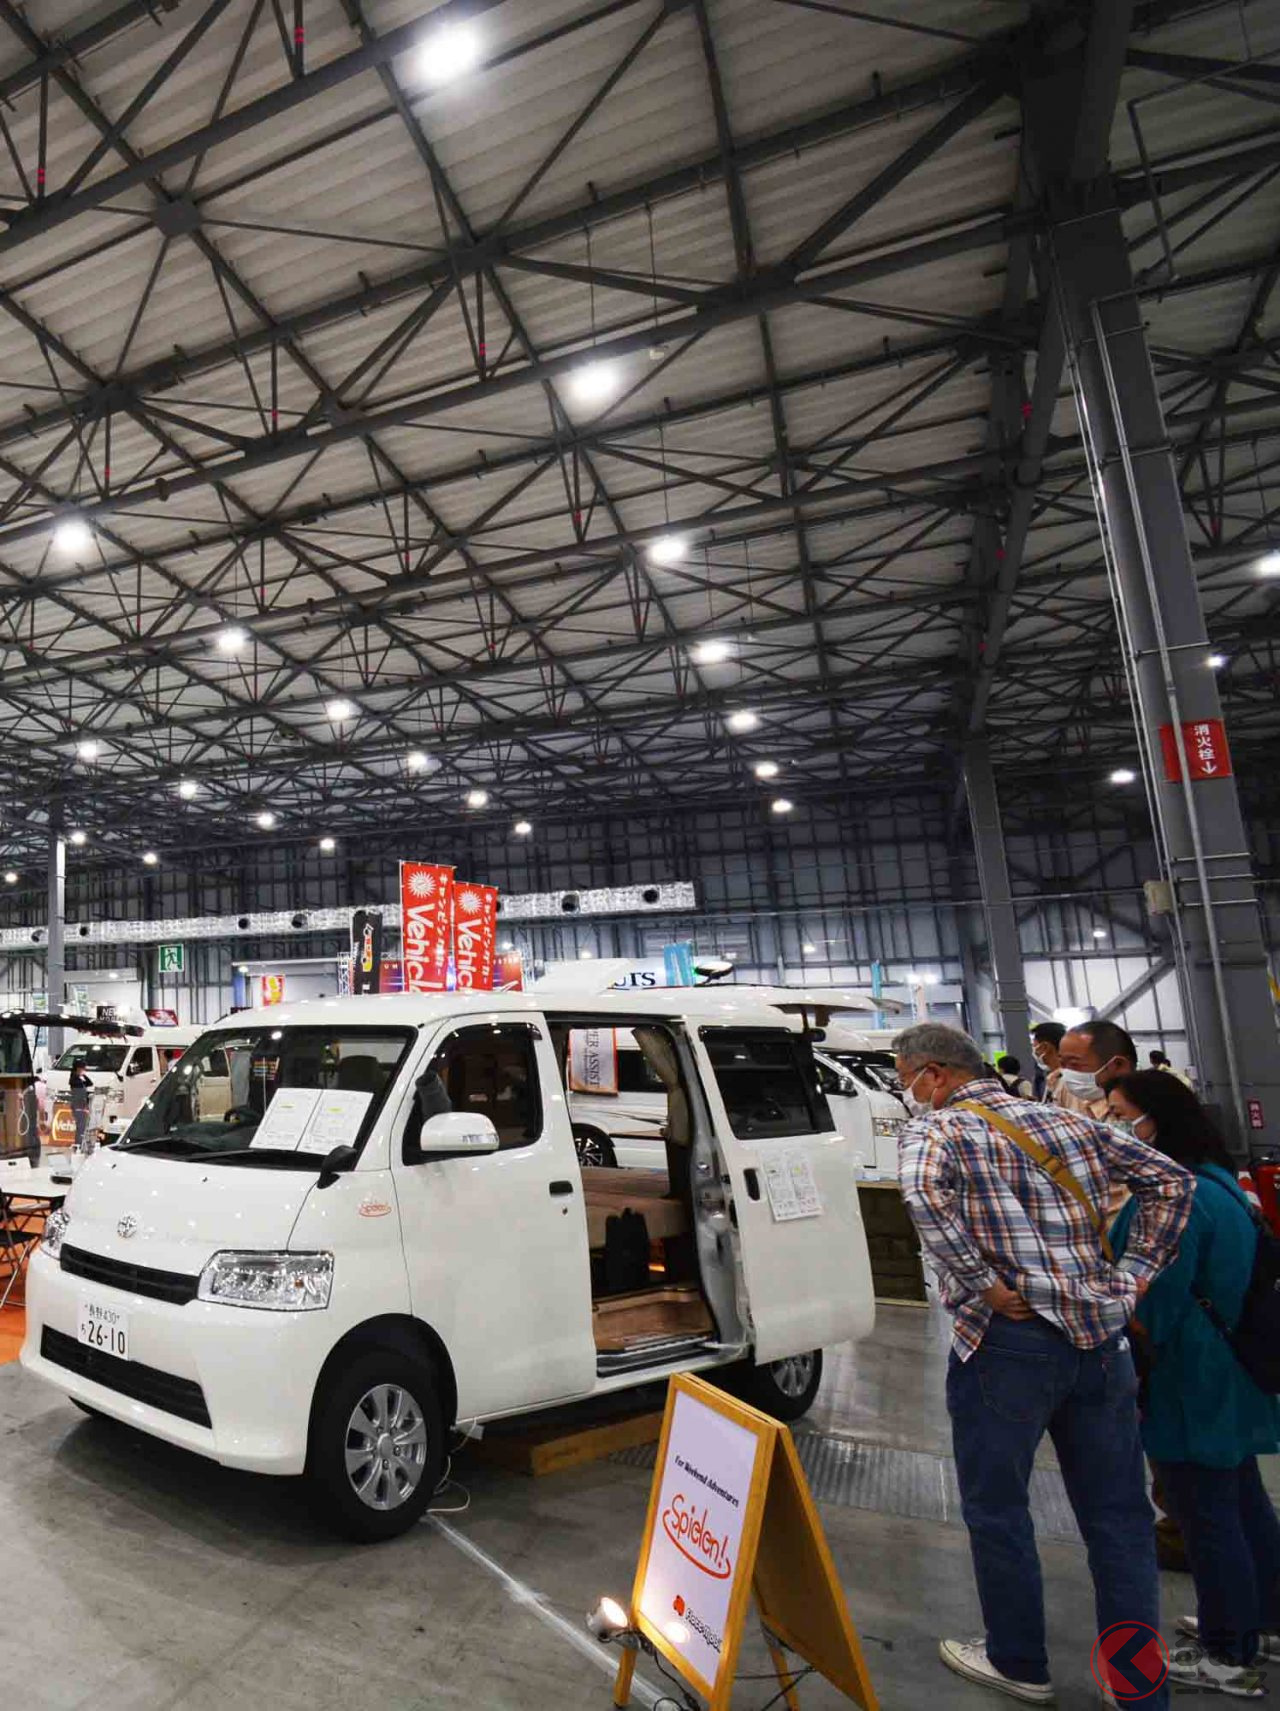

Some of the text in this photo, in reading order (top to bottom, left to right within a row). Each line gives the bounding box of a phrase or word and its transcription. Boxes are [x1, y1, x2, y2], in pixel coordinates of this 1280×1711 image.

[1194, 723, 1216, 760] 消火栓
[457, 919, 482, 992] Vehic
[88, 1320, 126, 1354] 26-10
[670, 1493, 729, 1569] Spielen!
